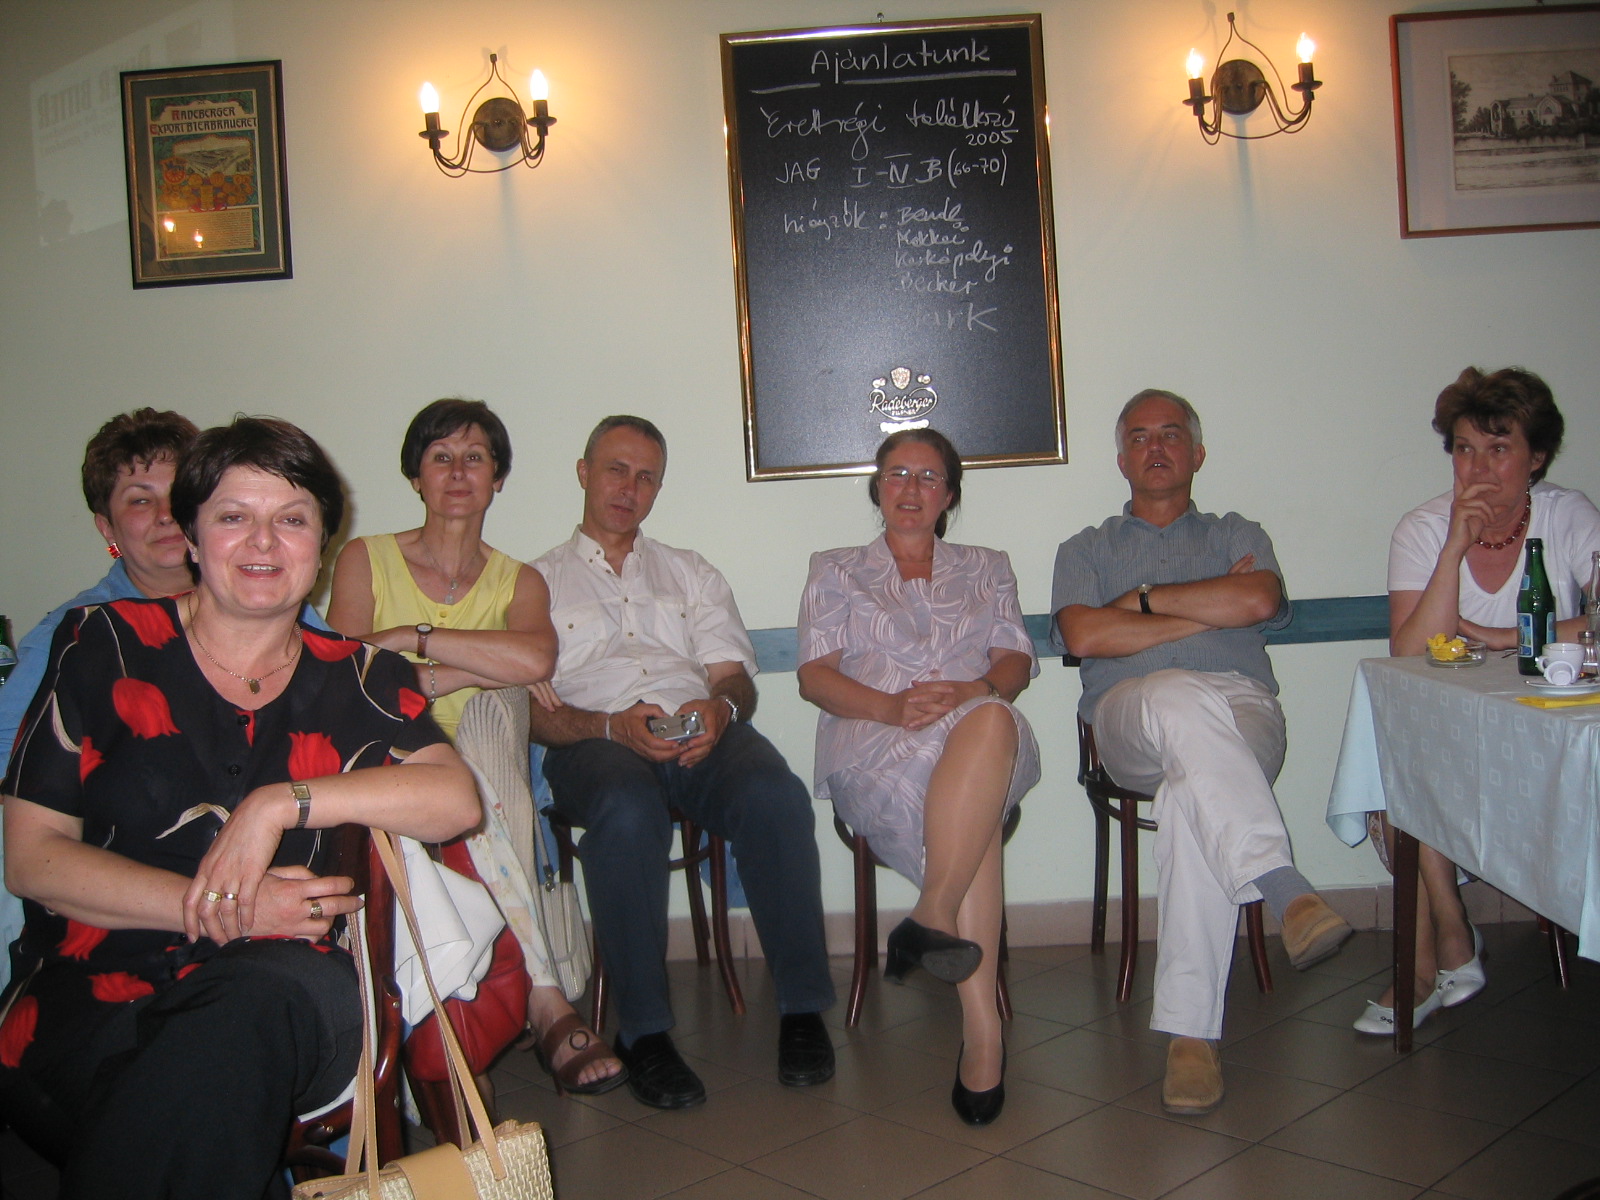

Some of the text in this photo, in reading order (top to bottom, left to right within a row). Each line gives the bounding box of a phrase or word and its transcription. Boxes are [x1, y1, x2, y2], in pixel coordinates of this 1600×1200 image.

[171, 106, 236, 121] RADEBERGER
[965, 129, 1019, 146] 2005
[776, 157, 820, 184] JAG
[947, 148, 1007, 189] (66-70)
